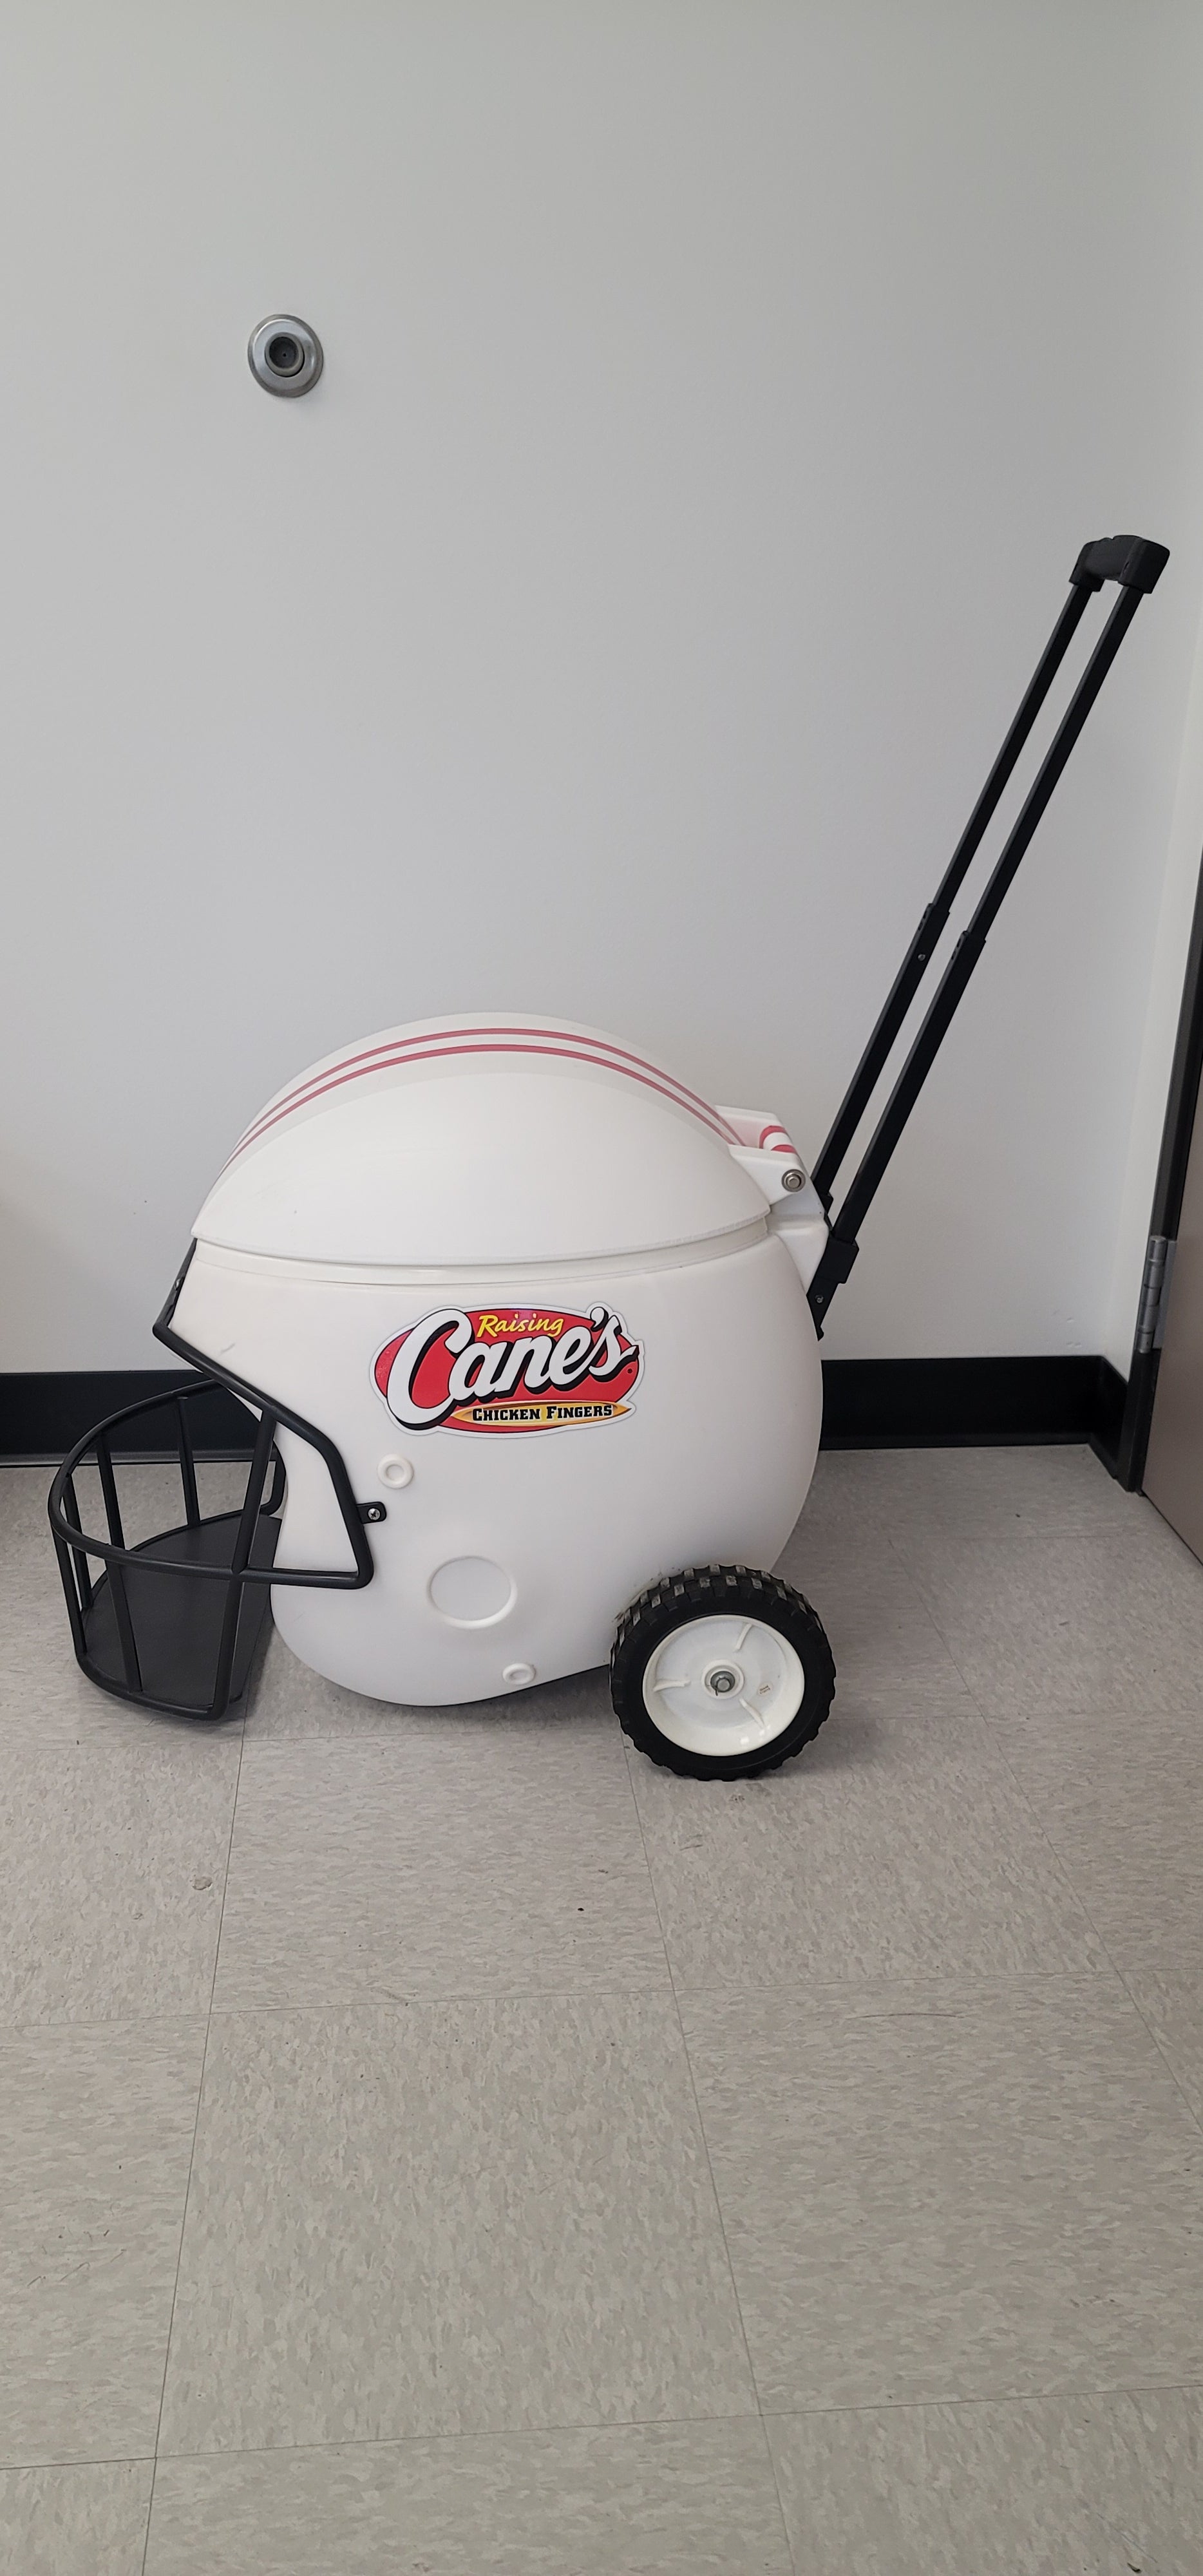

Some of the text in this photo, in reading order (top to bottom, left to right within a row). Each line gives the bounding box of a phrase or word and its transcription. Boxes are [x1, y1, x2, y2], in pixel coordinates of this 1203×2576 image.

[477, 1313, 564, 1338] Raising
[386, 1306, 639, 1430] Cane's
[472, 1405, 612, 1421] CHICKEN FINGERS
